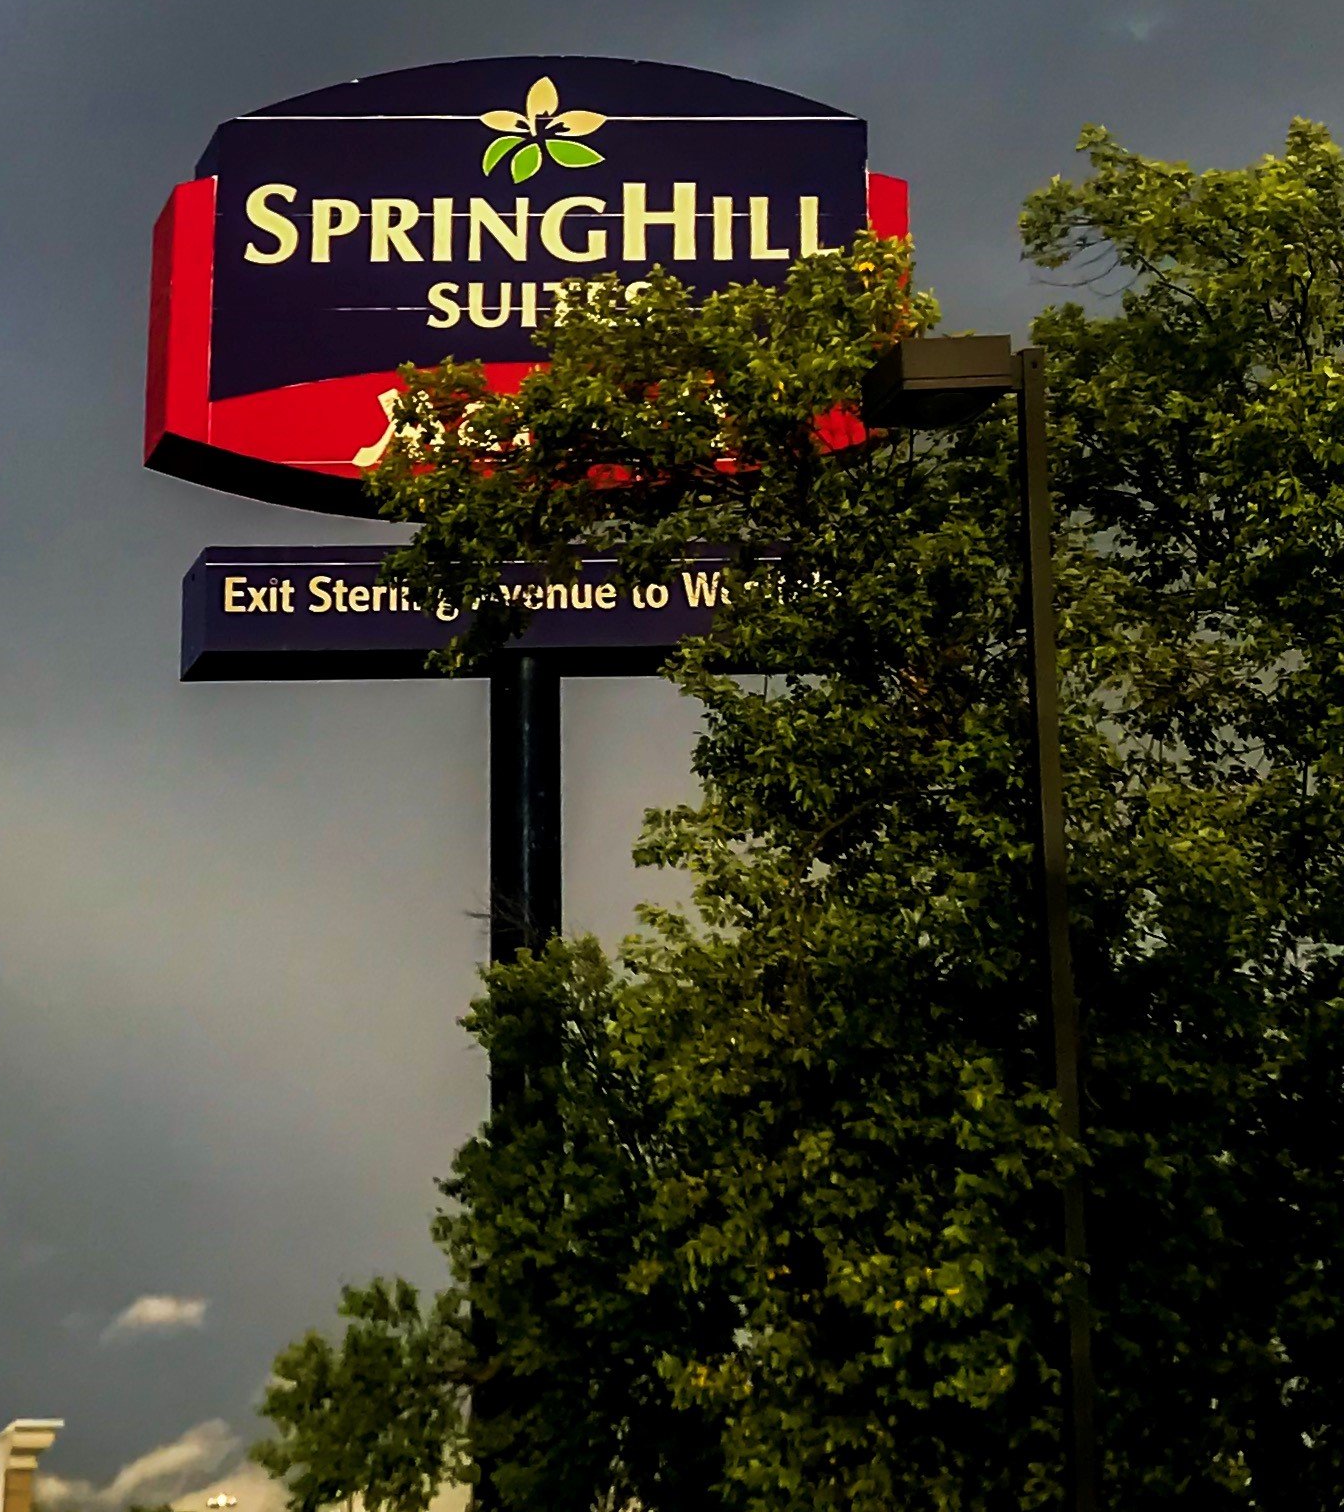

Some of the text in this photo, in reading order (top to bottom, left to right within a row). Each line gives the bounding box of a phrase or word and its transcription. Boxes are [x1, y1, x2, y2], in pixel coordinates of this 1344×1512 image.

[243, 182, 841, 265] SPRINGHILL
[223, 575, 295, 613] Exit
[308, 575, 460, 622] Sterlig
[633, 582, 669, 610] to
